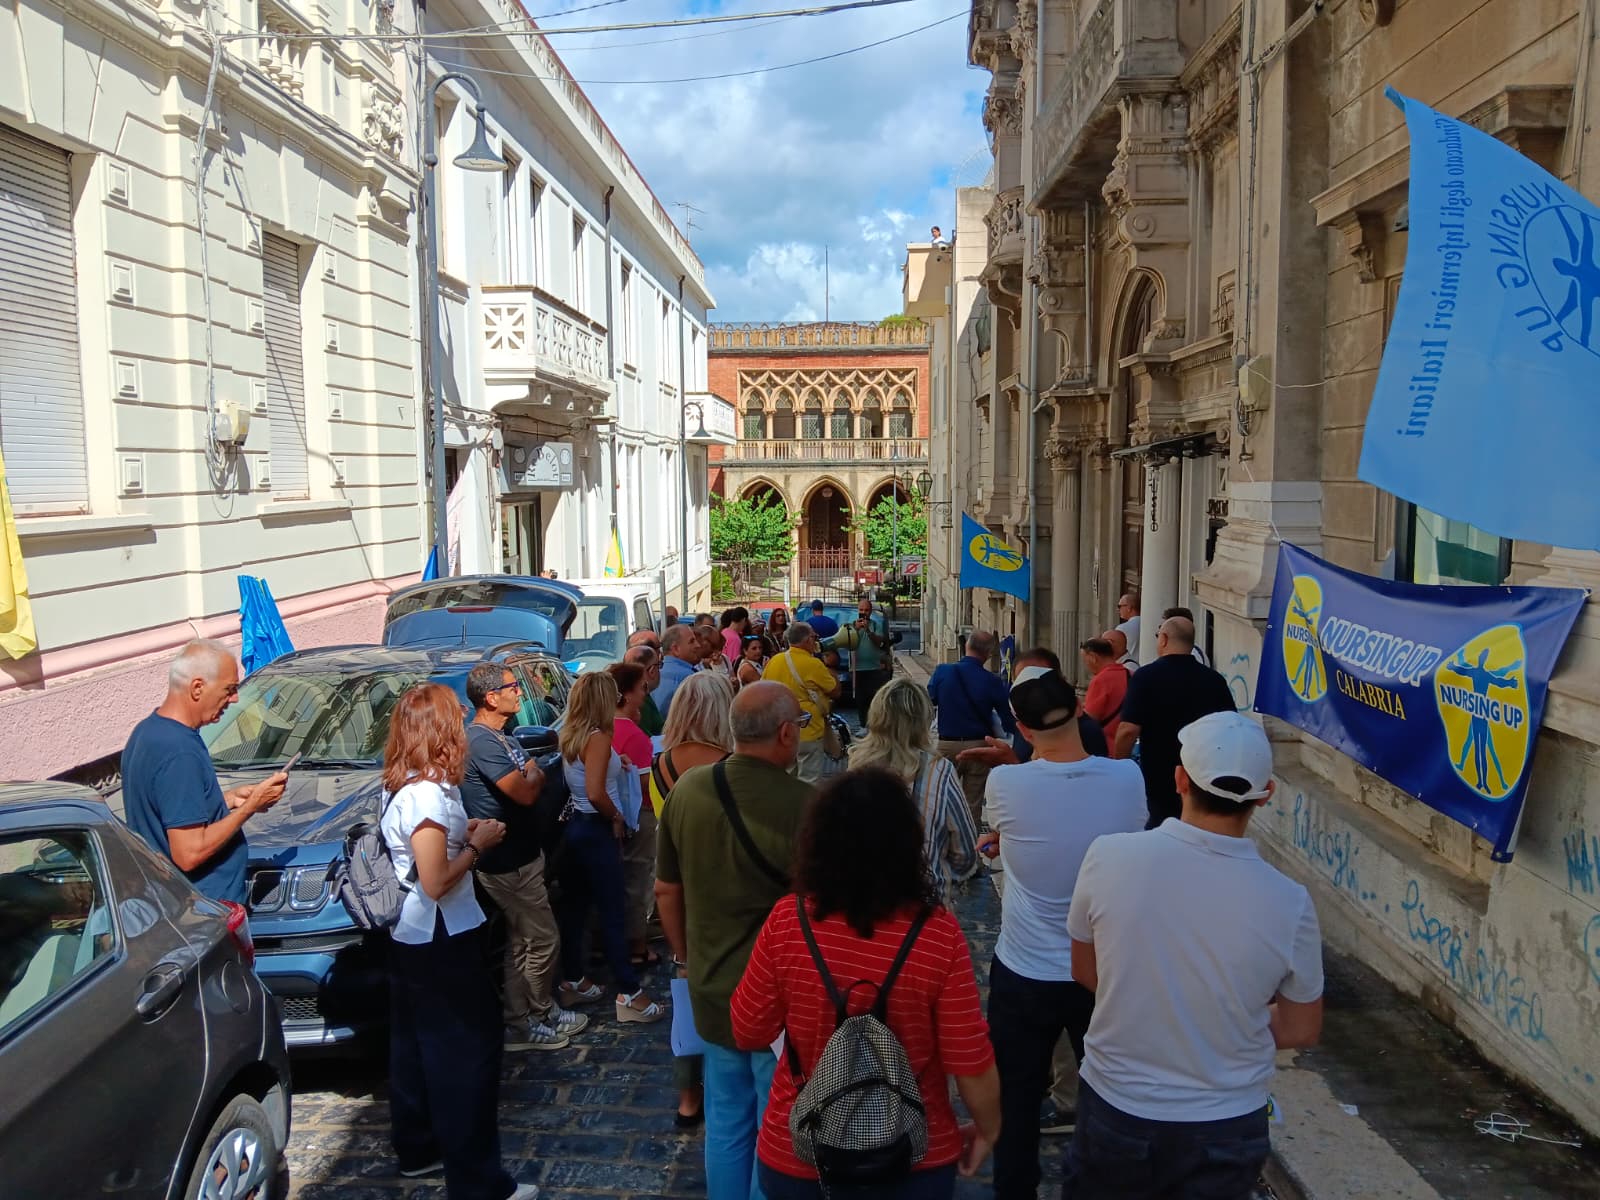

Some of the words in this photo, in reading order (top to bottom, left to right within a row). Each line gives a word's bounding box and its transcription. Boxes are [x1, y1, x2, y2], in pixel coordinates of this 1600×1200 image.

[1336, 669, 1406, 720] CALABRIA
[1440, 684, 1501, 722] NURSING
[1503, 703, 1523, 729] UP
